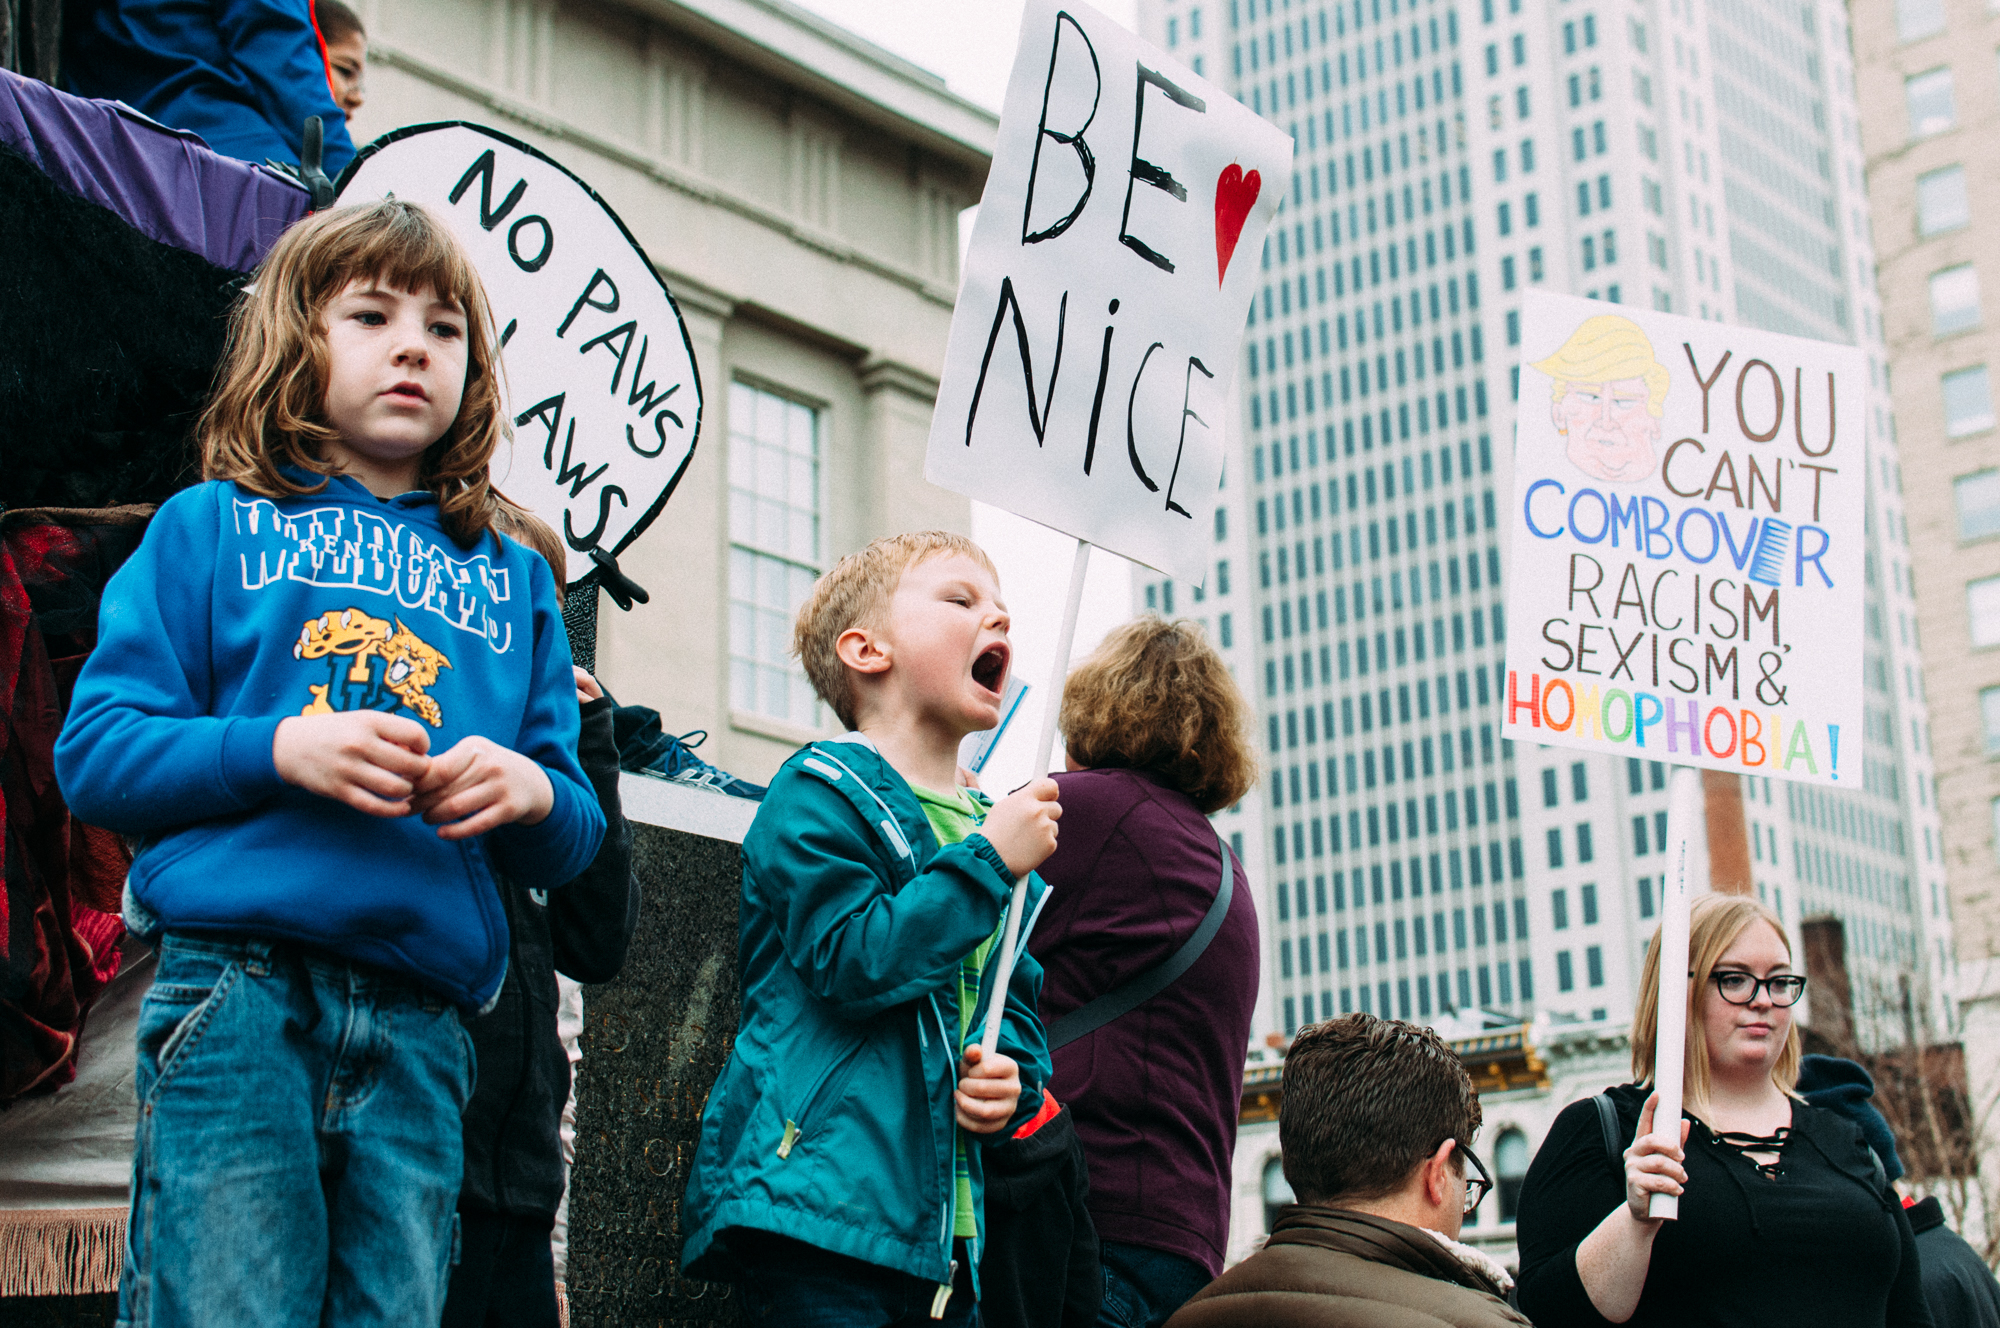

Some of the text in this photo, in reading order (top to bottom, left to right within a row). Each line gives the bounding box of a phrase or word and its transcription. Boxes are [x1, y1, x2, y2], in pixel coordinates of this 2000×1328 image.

[1022, 10, 1206, 274] BE
[449, 149, 684, 459] NO PAWS
[1683, 342, 1836, 458] YOU
[1524, 478, 1834, 589] COMBOVER
[1662, 437, 1838, 522] CAN'T
[1541, 618, 1789, 706] SEXISM &
[1507, 670, 1841, 780] HOMOPHOBIA!
